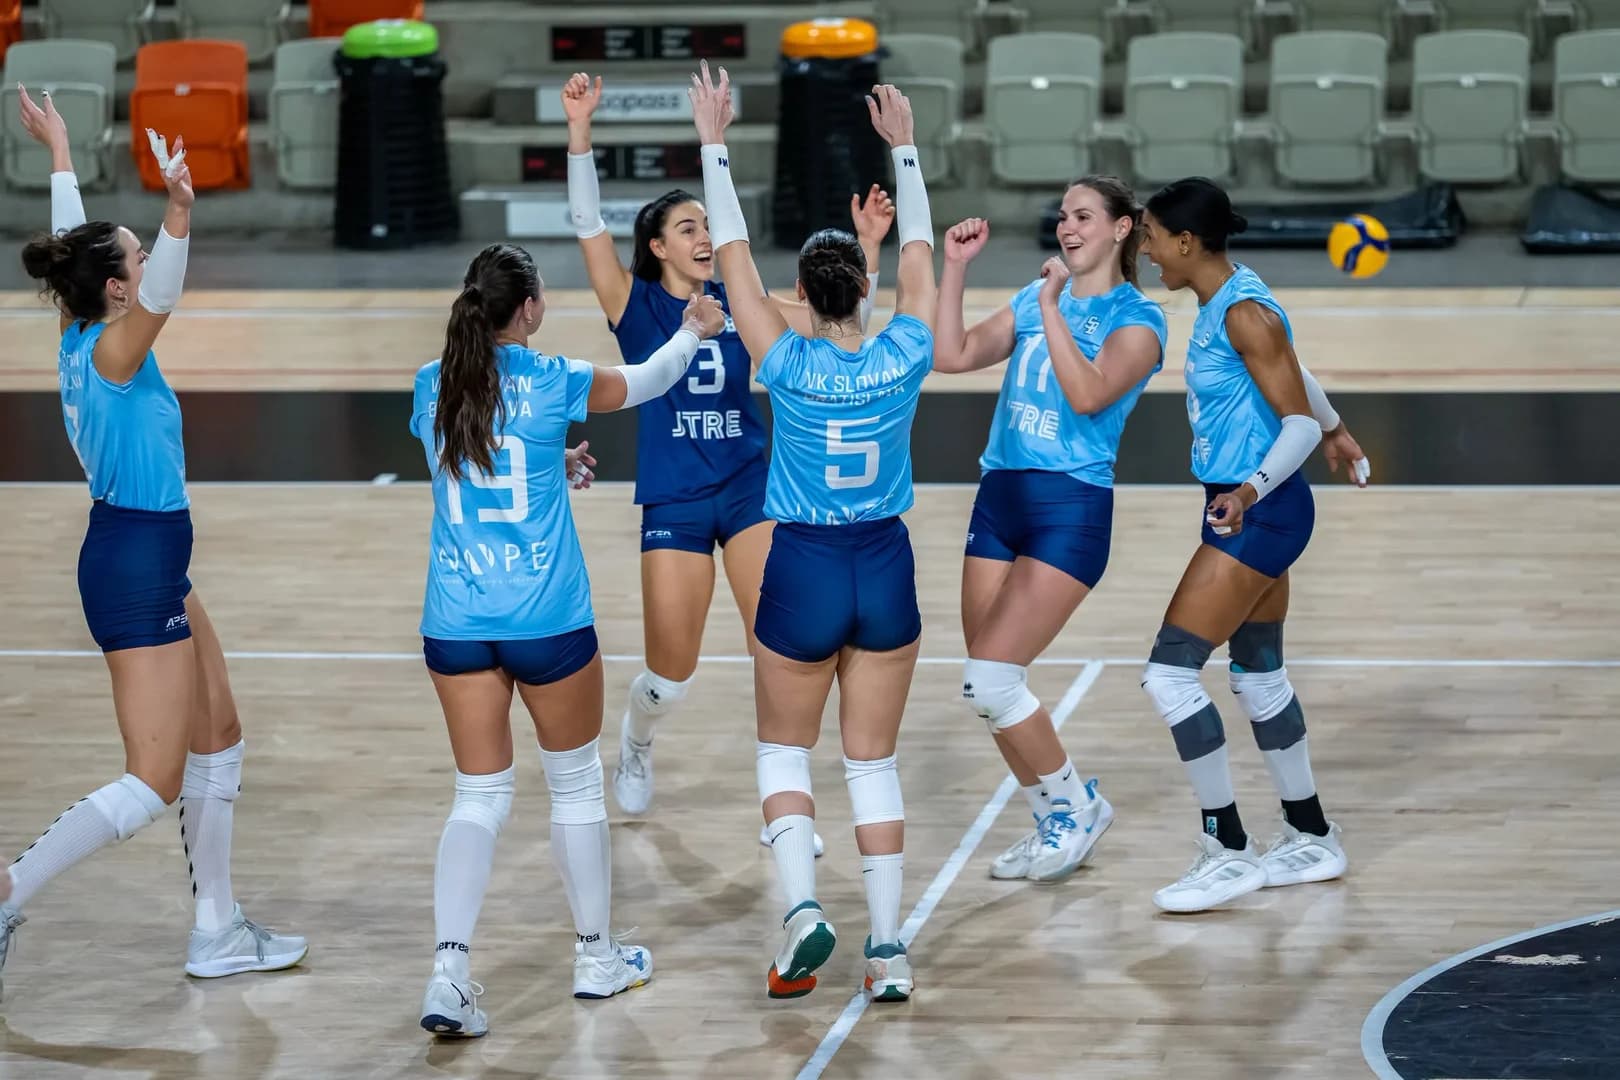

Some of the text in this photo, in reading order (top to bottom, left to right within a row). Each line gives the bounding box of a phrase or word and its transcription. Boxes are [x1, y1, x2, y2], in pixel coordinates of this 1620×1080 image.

[687, 340, 726, 395] 3
[806, 366, 906, 393] VK SLOVAN
[672, 410, 743, 440] JTRE
[1007, 400, 1059, 440] TRE
[825, 416, 880, 490] 5
[434, 435, 529, 525] 19
